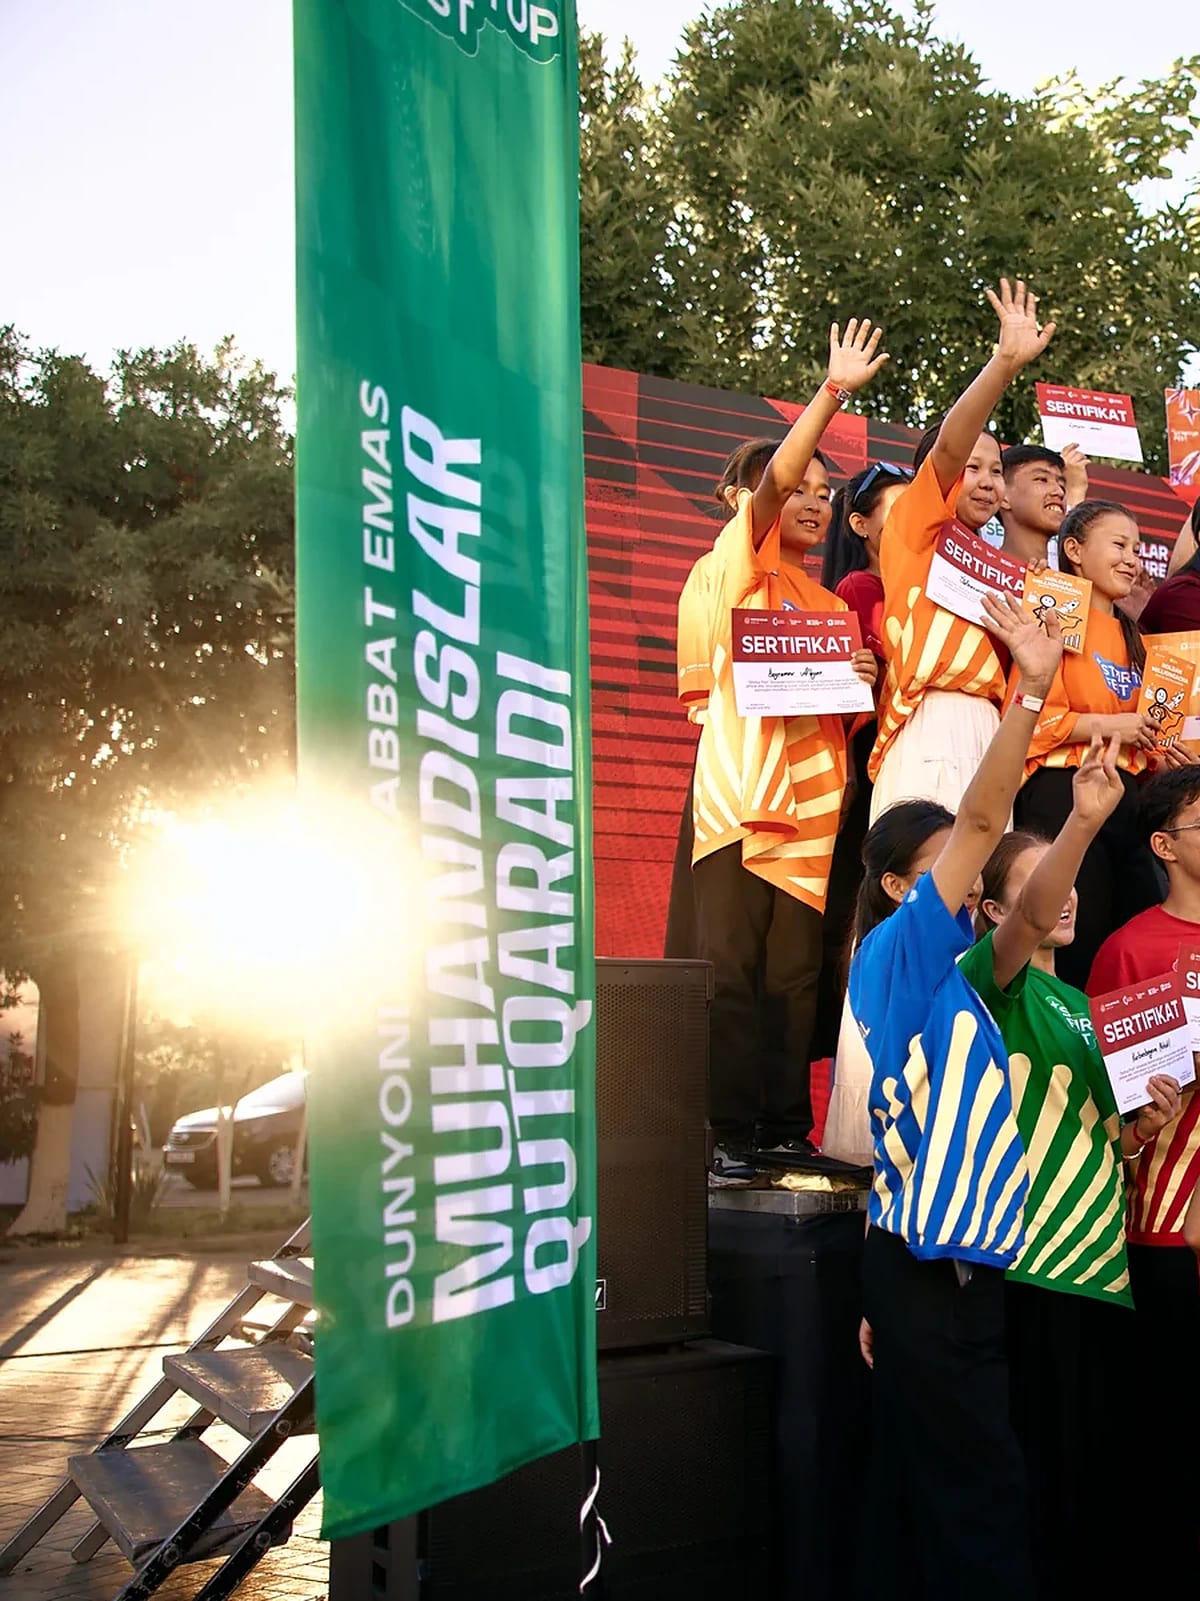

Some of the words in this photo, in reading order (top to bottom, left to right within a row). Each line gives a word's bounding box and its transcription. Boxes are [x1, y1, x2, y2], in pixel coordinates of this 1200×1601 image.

[1046, 399, 1127, 422] SERTIFIKAT
[360, 379, 396, 573] EMAS
[944, 538, 1025, 592] SERTIFIKA
[362, 586, 402, 820] ABBAT
[741, 635, 851, 654] SERTIFIKAT
[401, 404, 515, 1325] MUHANDISLAR
[495, 650, 592, 1295] QUTQARADI
[1103, 1000, 1180, 1043] SERTIFIKAT
